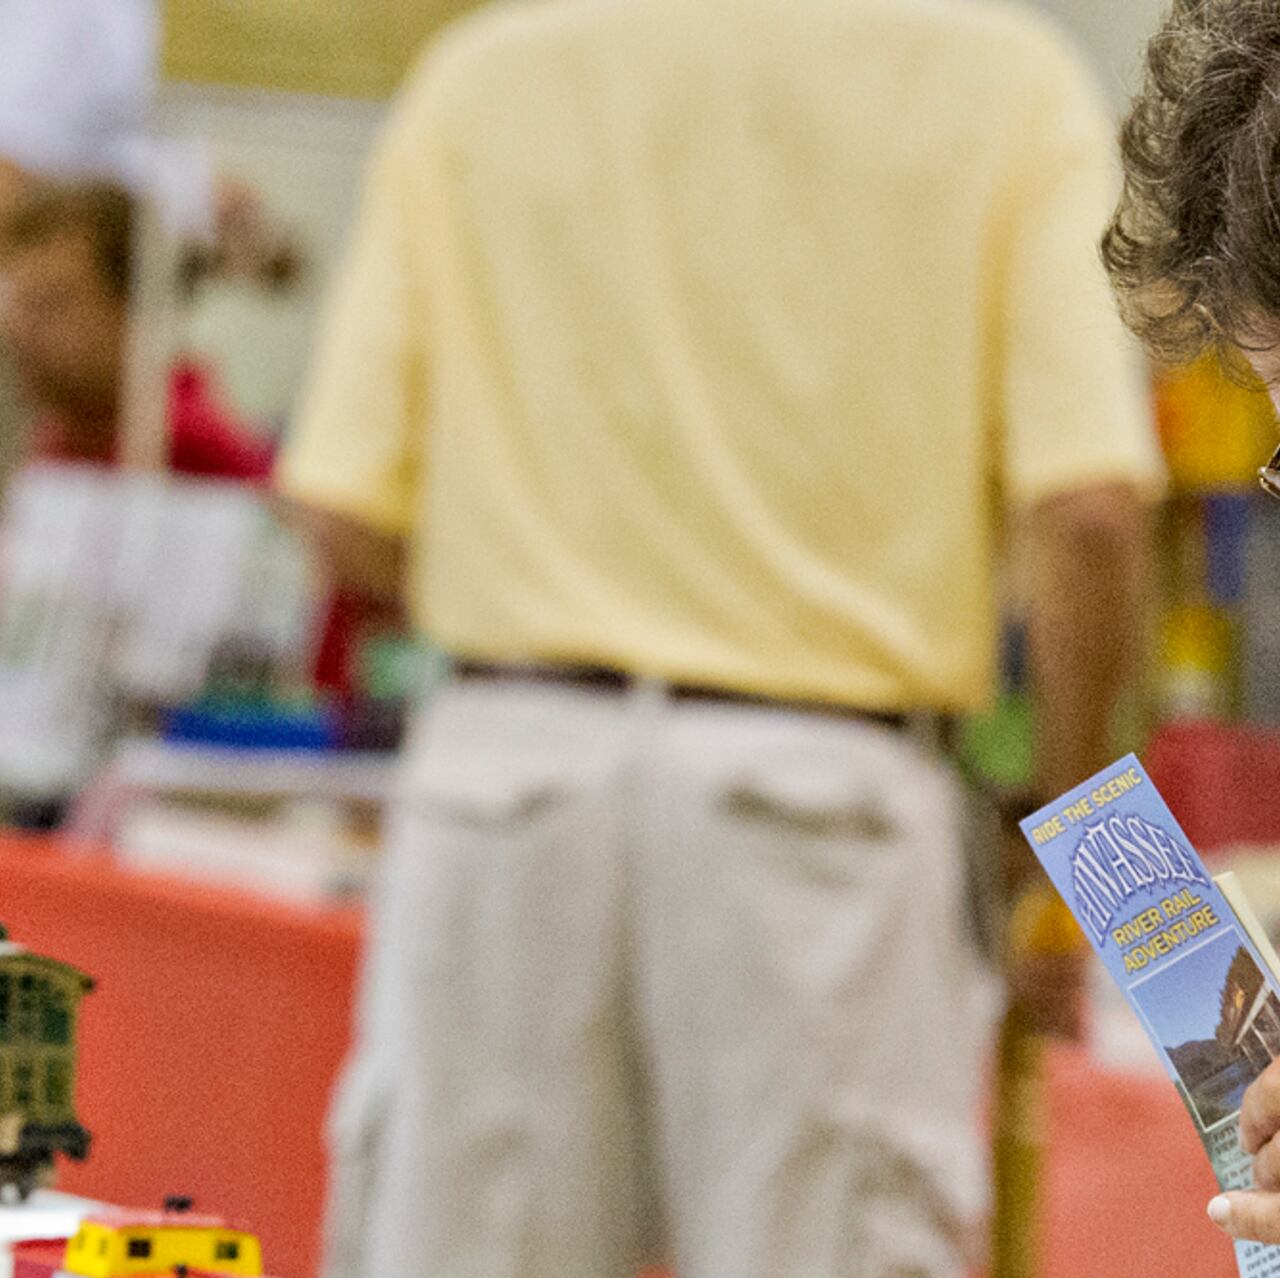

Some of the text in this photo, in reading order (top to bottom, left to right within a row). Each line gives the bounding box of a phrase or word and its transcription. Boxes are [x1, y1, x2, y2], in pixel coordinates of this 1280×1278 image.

[1032, 768, 1142, 845] RIDE THE SCENIC
[1072, 815, 1208, 946] HIWASSEE
[1111, 887, 1201, 946] RIVER RAIL
[1122, 904, 1219, 976] ADVENTURE
